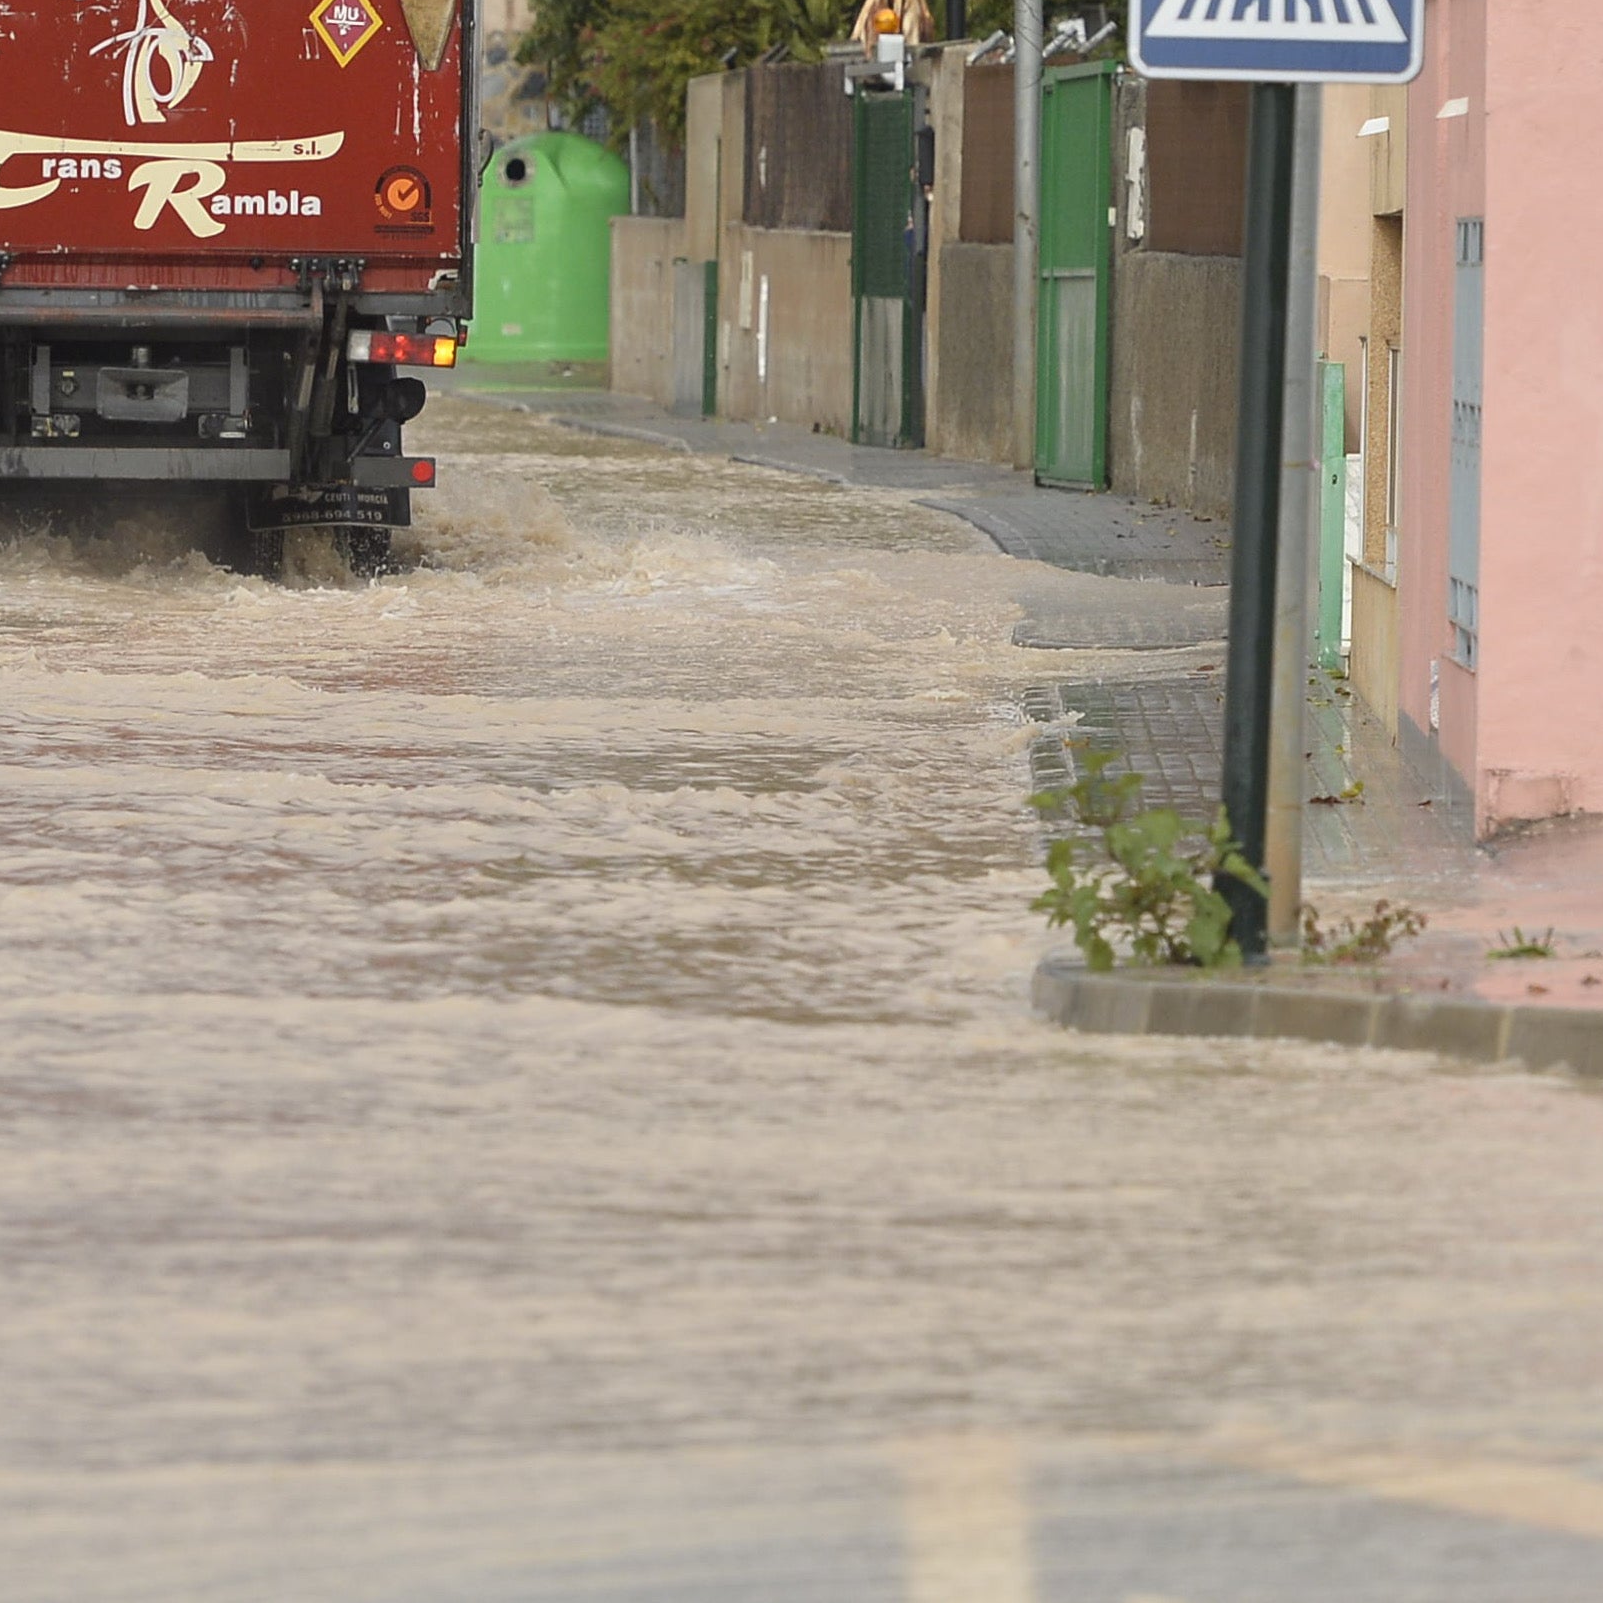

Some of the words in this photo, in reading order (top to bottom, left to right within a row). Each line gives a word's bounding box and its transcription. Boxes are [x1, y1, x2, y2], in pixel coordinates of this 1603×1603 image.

[333, 5, 359, 21] MU
[293, 140, 322, 156] s.l.
[128, 159, 322, 238] Rambla
[356, 509, 383, 522] 519
